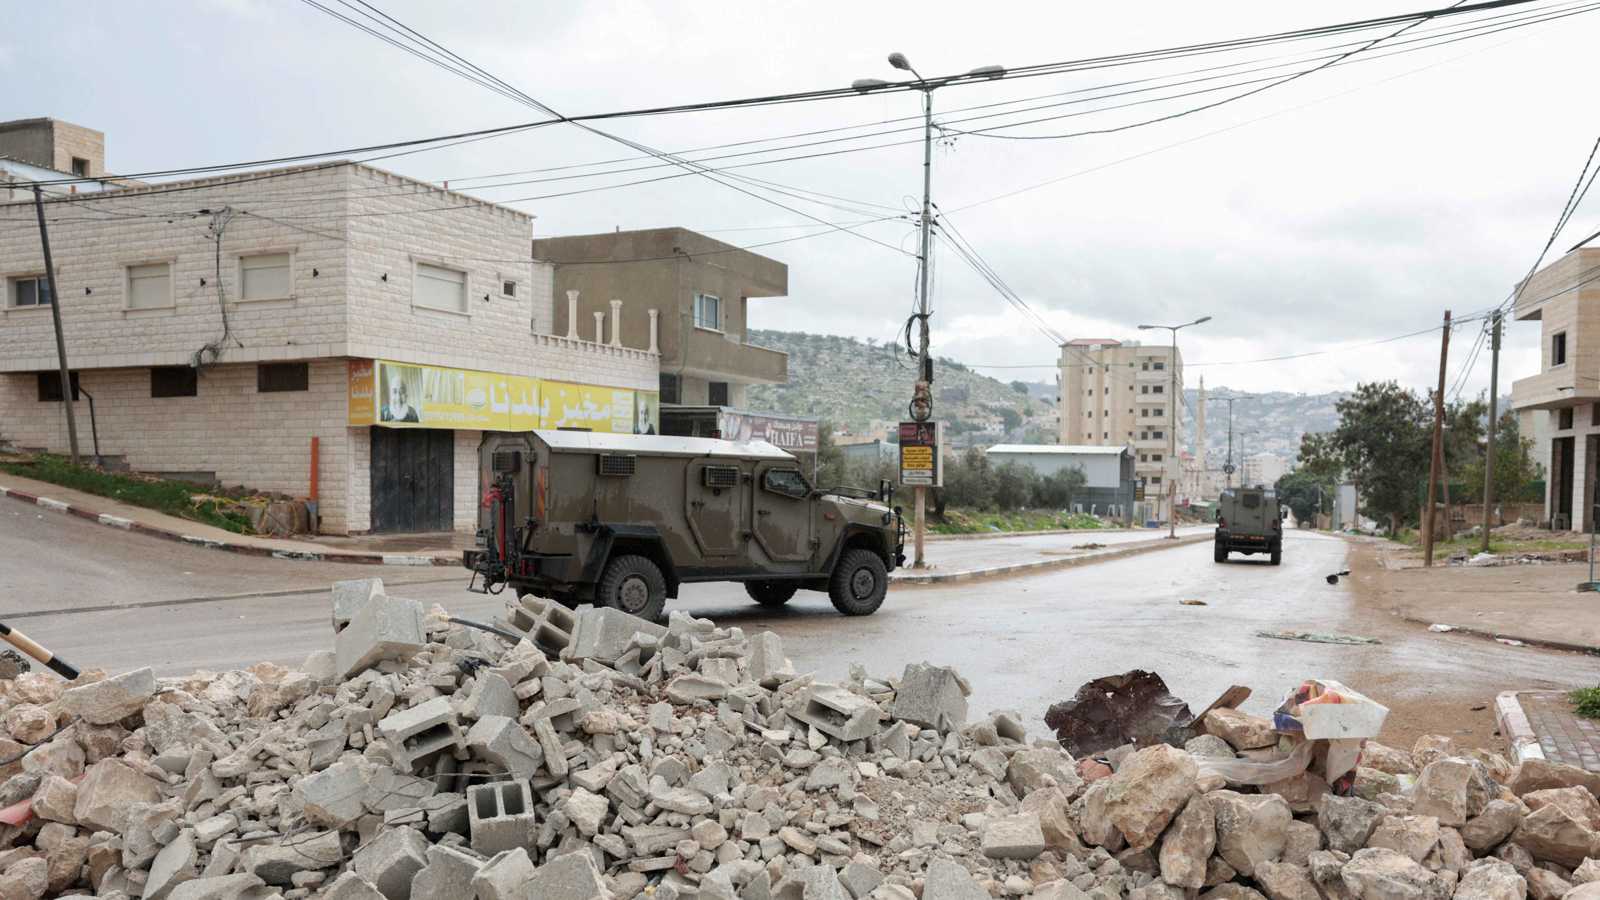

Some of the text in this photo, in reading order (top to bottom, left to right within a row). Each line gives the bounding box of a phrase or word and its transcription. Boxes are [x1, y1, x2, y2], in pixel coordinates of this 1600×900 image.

[490, 382, 549, 427] بلدنا
[556, 389, 610, 428] مخبز
[771, 430, 804, 447] HAIFA
